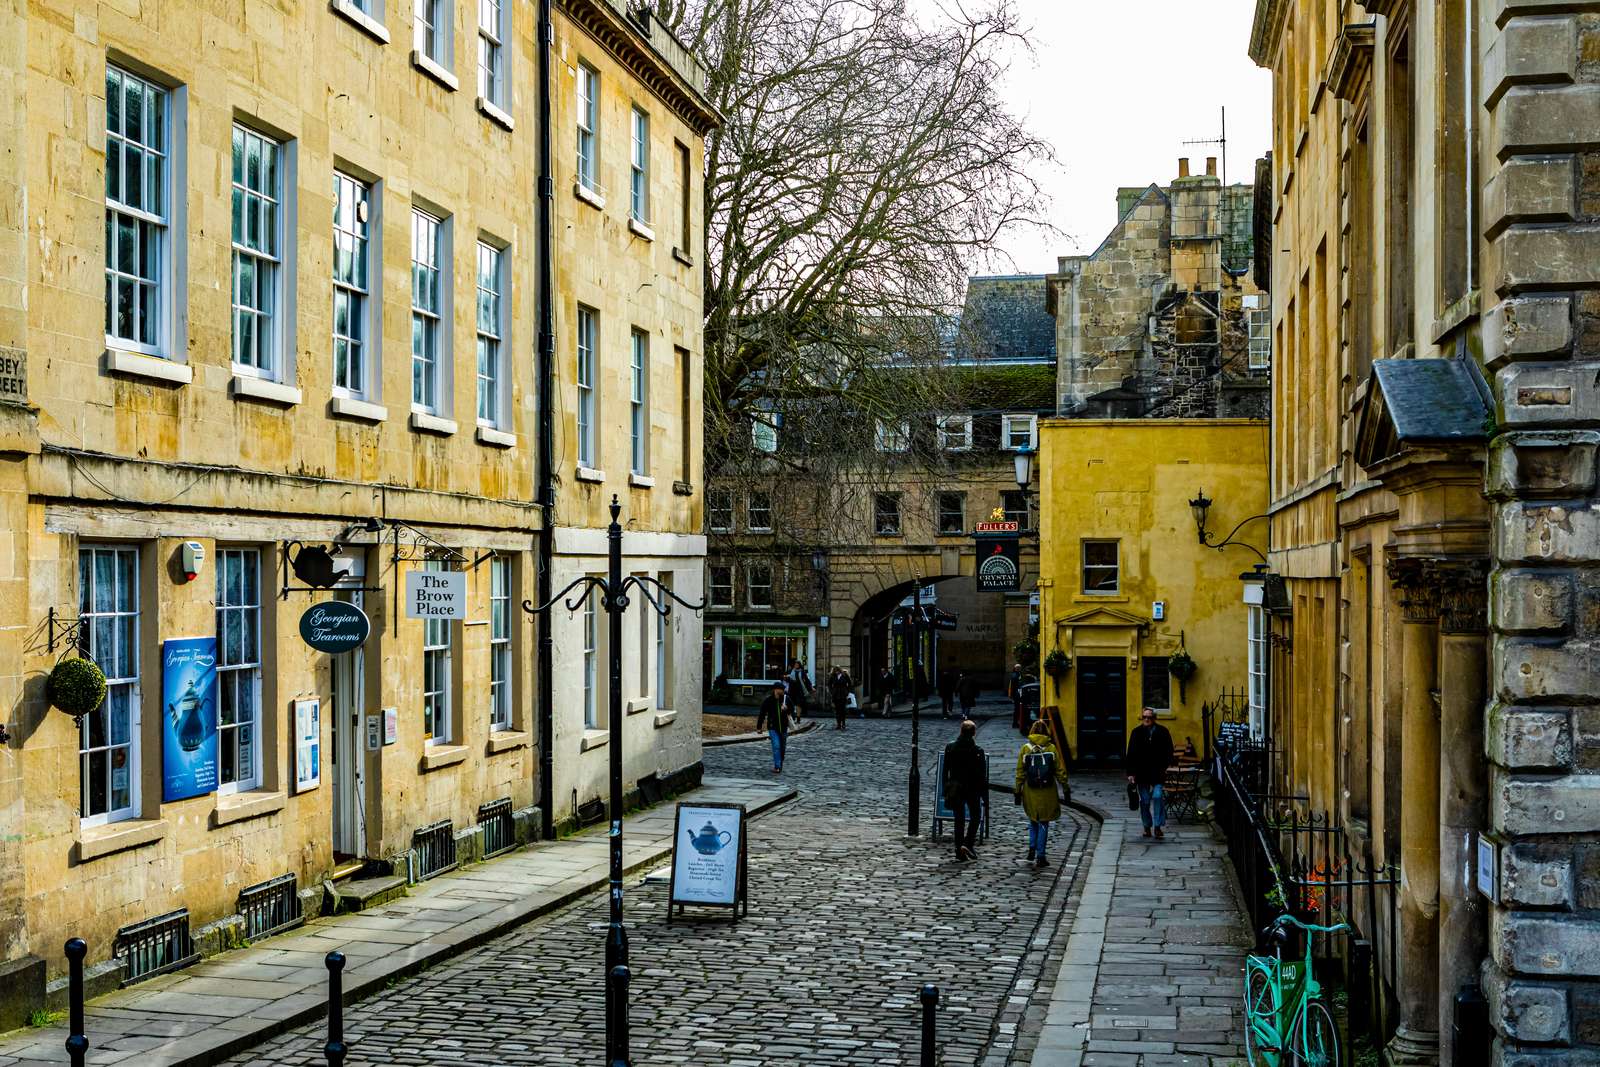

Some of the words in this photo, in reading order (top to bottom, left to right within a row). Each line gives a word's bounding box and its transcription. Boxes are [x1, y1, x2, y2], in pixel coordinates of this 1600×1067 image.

[0, 377, 23, 394] EET
[421, 575, 449, 588] The
[415, 588, 455, 602] Brow
[415, 602, 455, 616] Place
[309, 607, 360, 628] Georgian
[310, 627, 361, 641] Tearooms
